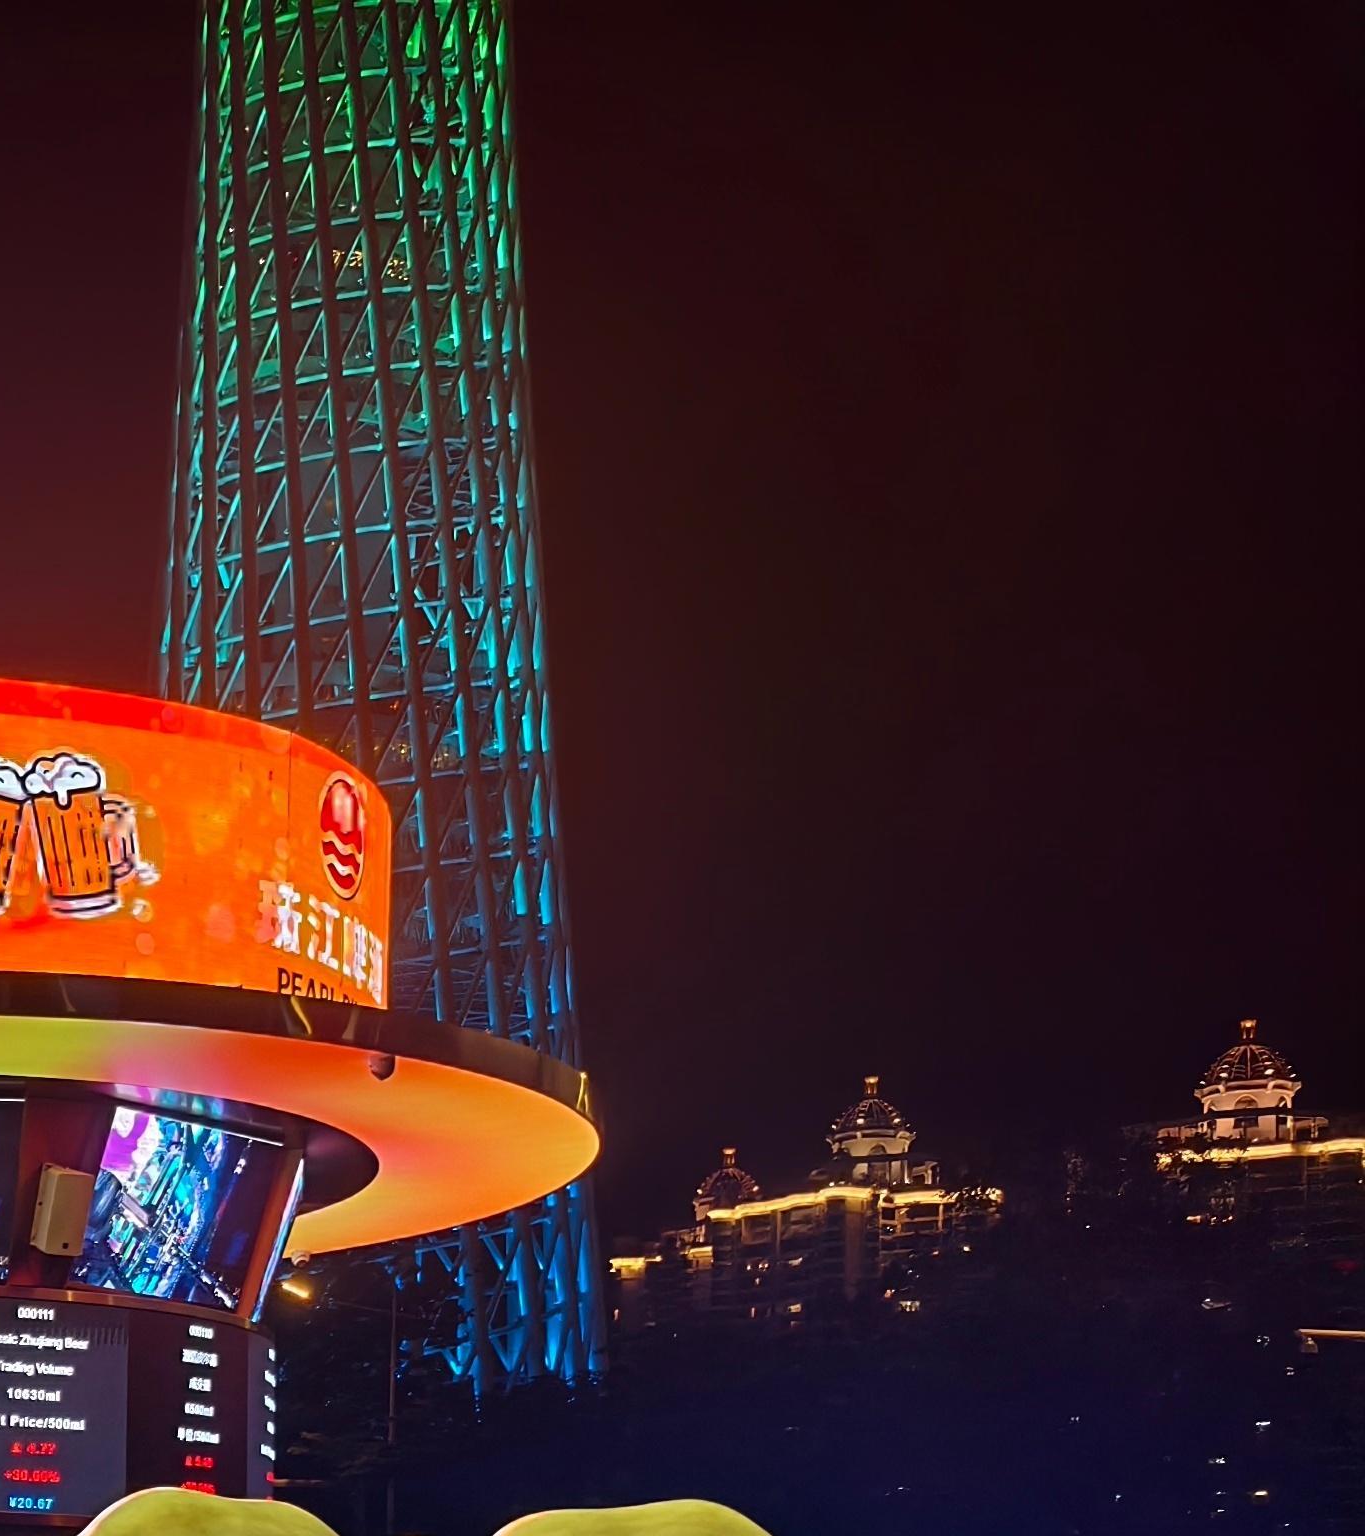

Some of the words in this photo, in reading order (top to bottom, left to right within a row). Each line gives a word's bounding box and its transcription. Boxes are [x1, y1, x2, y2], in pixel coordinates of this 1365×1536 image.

[17, 1307, 54, 1320] 000111
[64, 1337, 89, 1350] Beer
[35, 1362, 74, 1376] Volume
[9, 1414, 85, 1431] Price/500ml
[9, 1496, 54, 1510] ¥20.67
